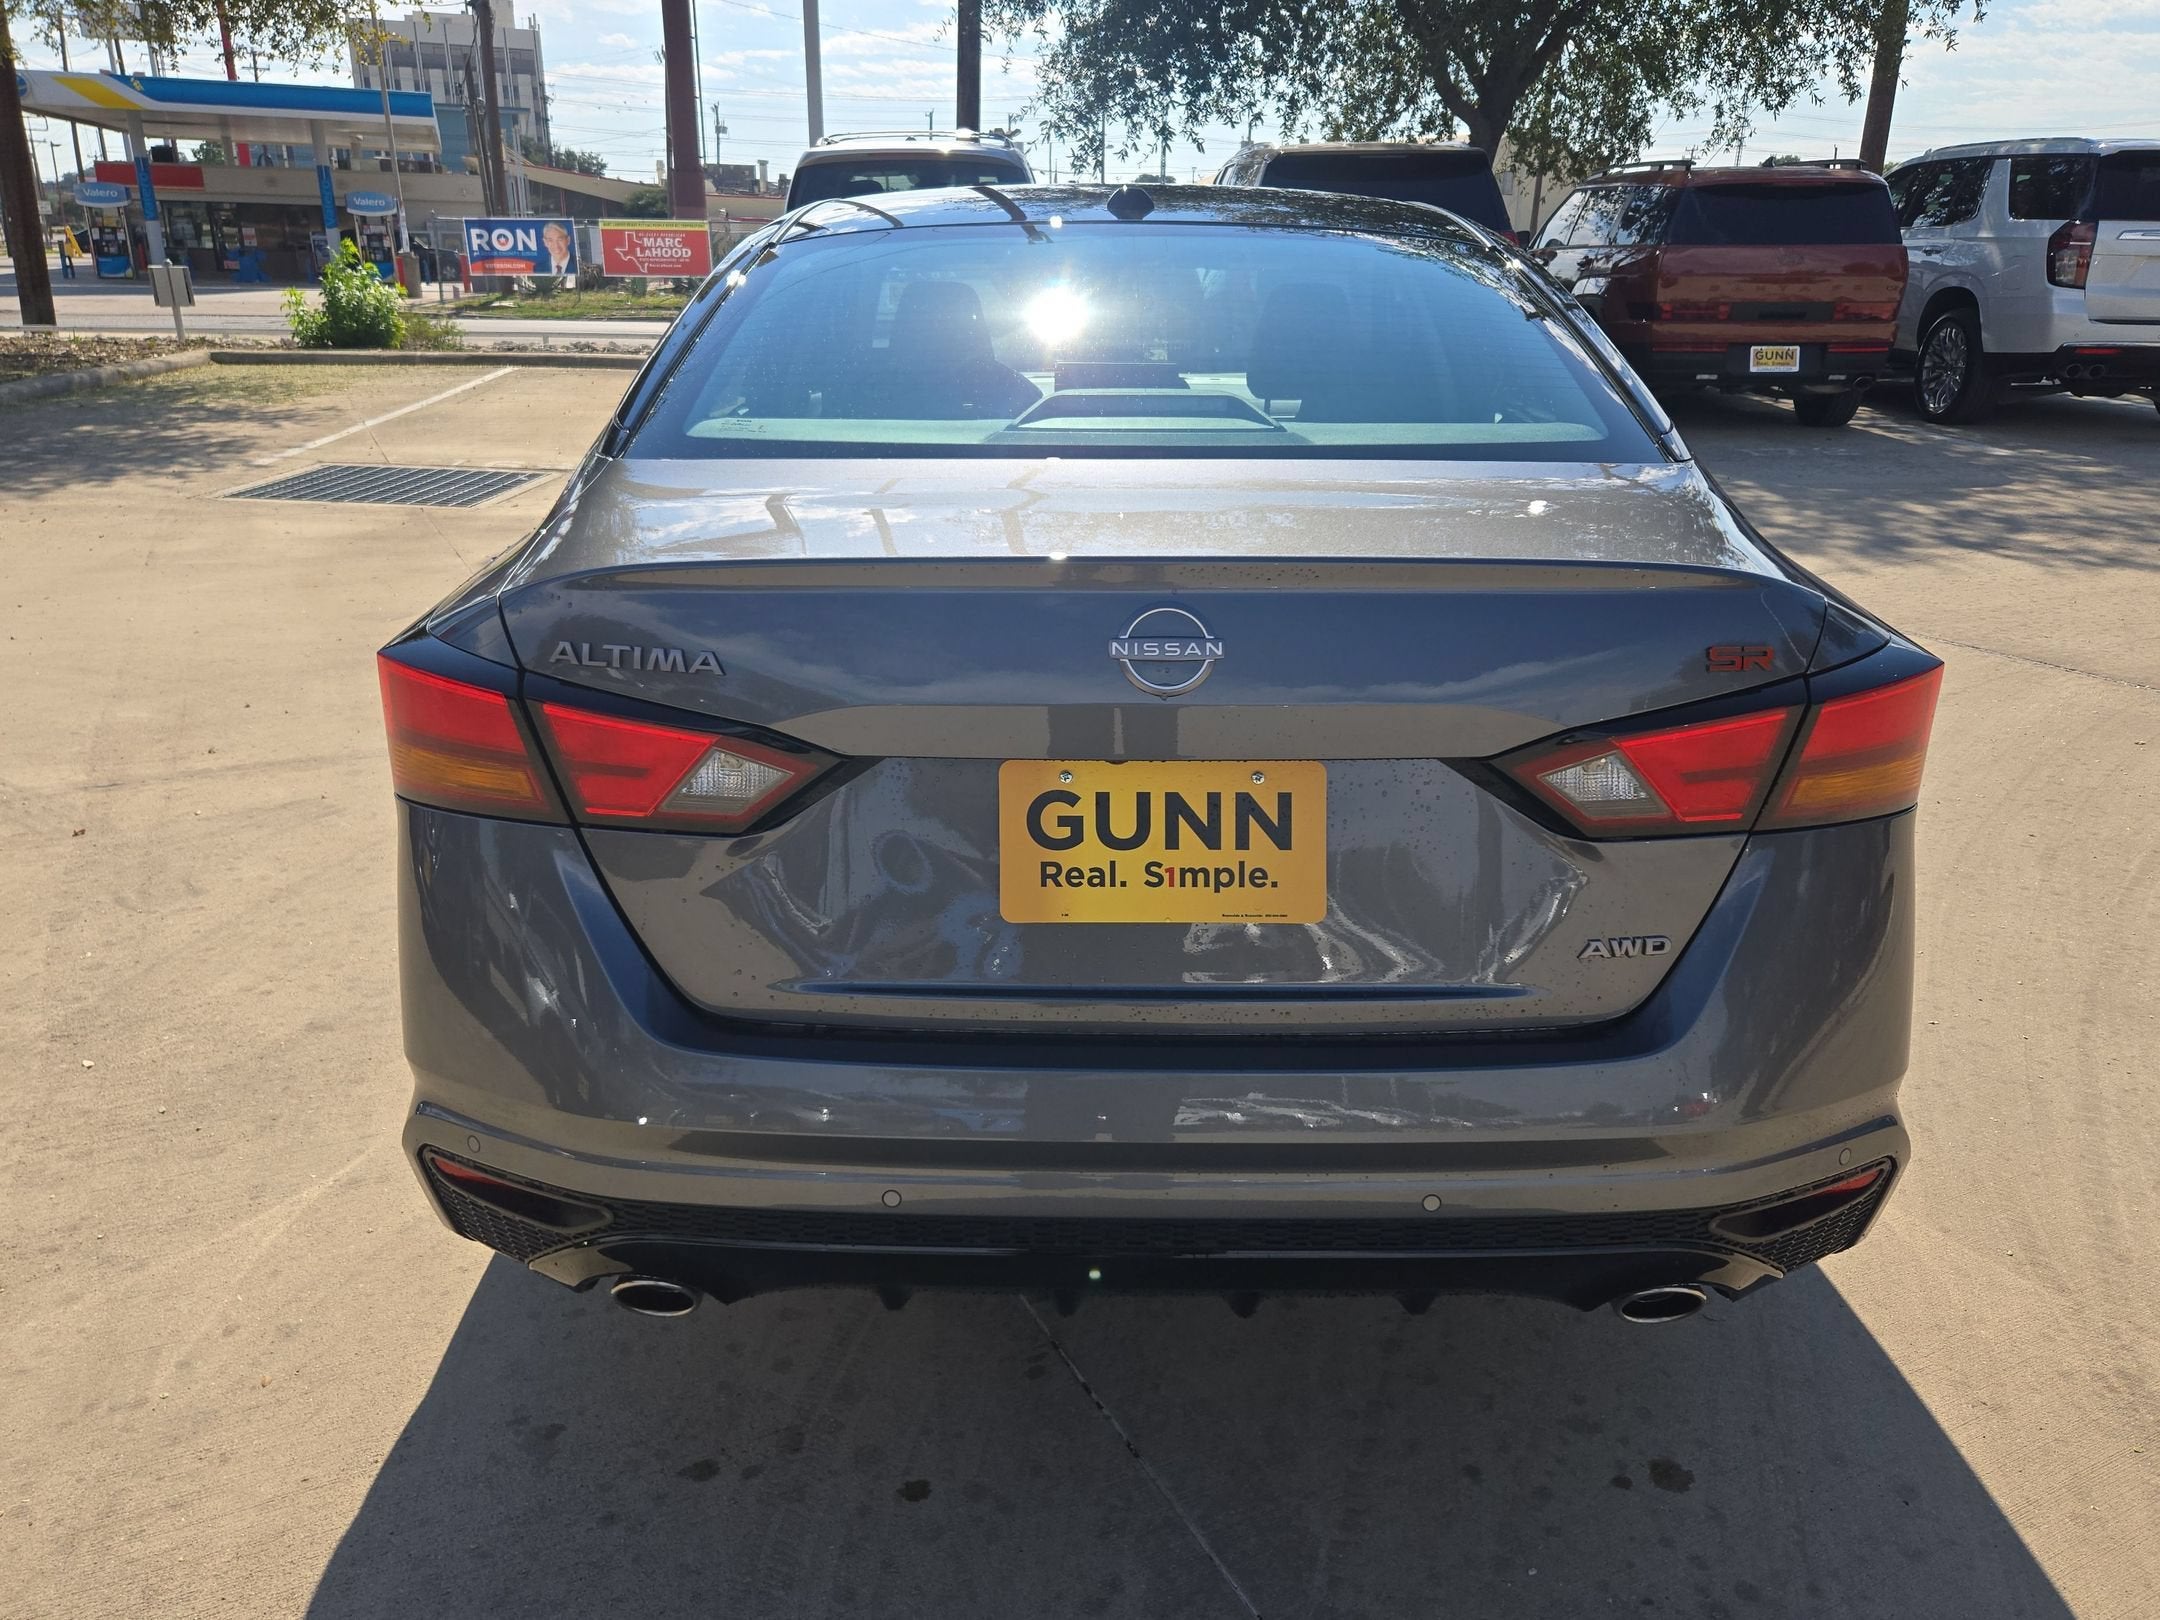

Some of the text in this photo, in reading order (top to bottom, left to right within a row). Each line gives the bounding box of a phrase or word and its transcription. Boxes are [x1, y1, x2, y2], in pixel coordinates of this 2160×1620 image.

[83, 188, 118, 197] Valero
[353, 197, 386, 206] Valero
[470, 228, 537, 251] RON
[643, 237, 683, 248] MARC
[1755, 350, 1794, 360] GUNN
[549, 641, 726, 676] ALTIMA
[1111, 641, 1223, 656] NISSAN
[1706, 645, 1774, 673] SR
[1026, 789, 1293, 851] GUNN
[1040, 861, 1128, 888] Real.
[1577, 936, 1672, 959] AWD
